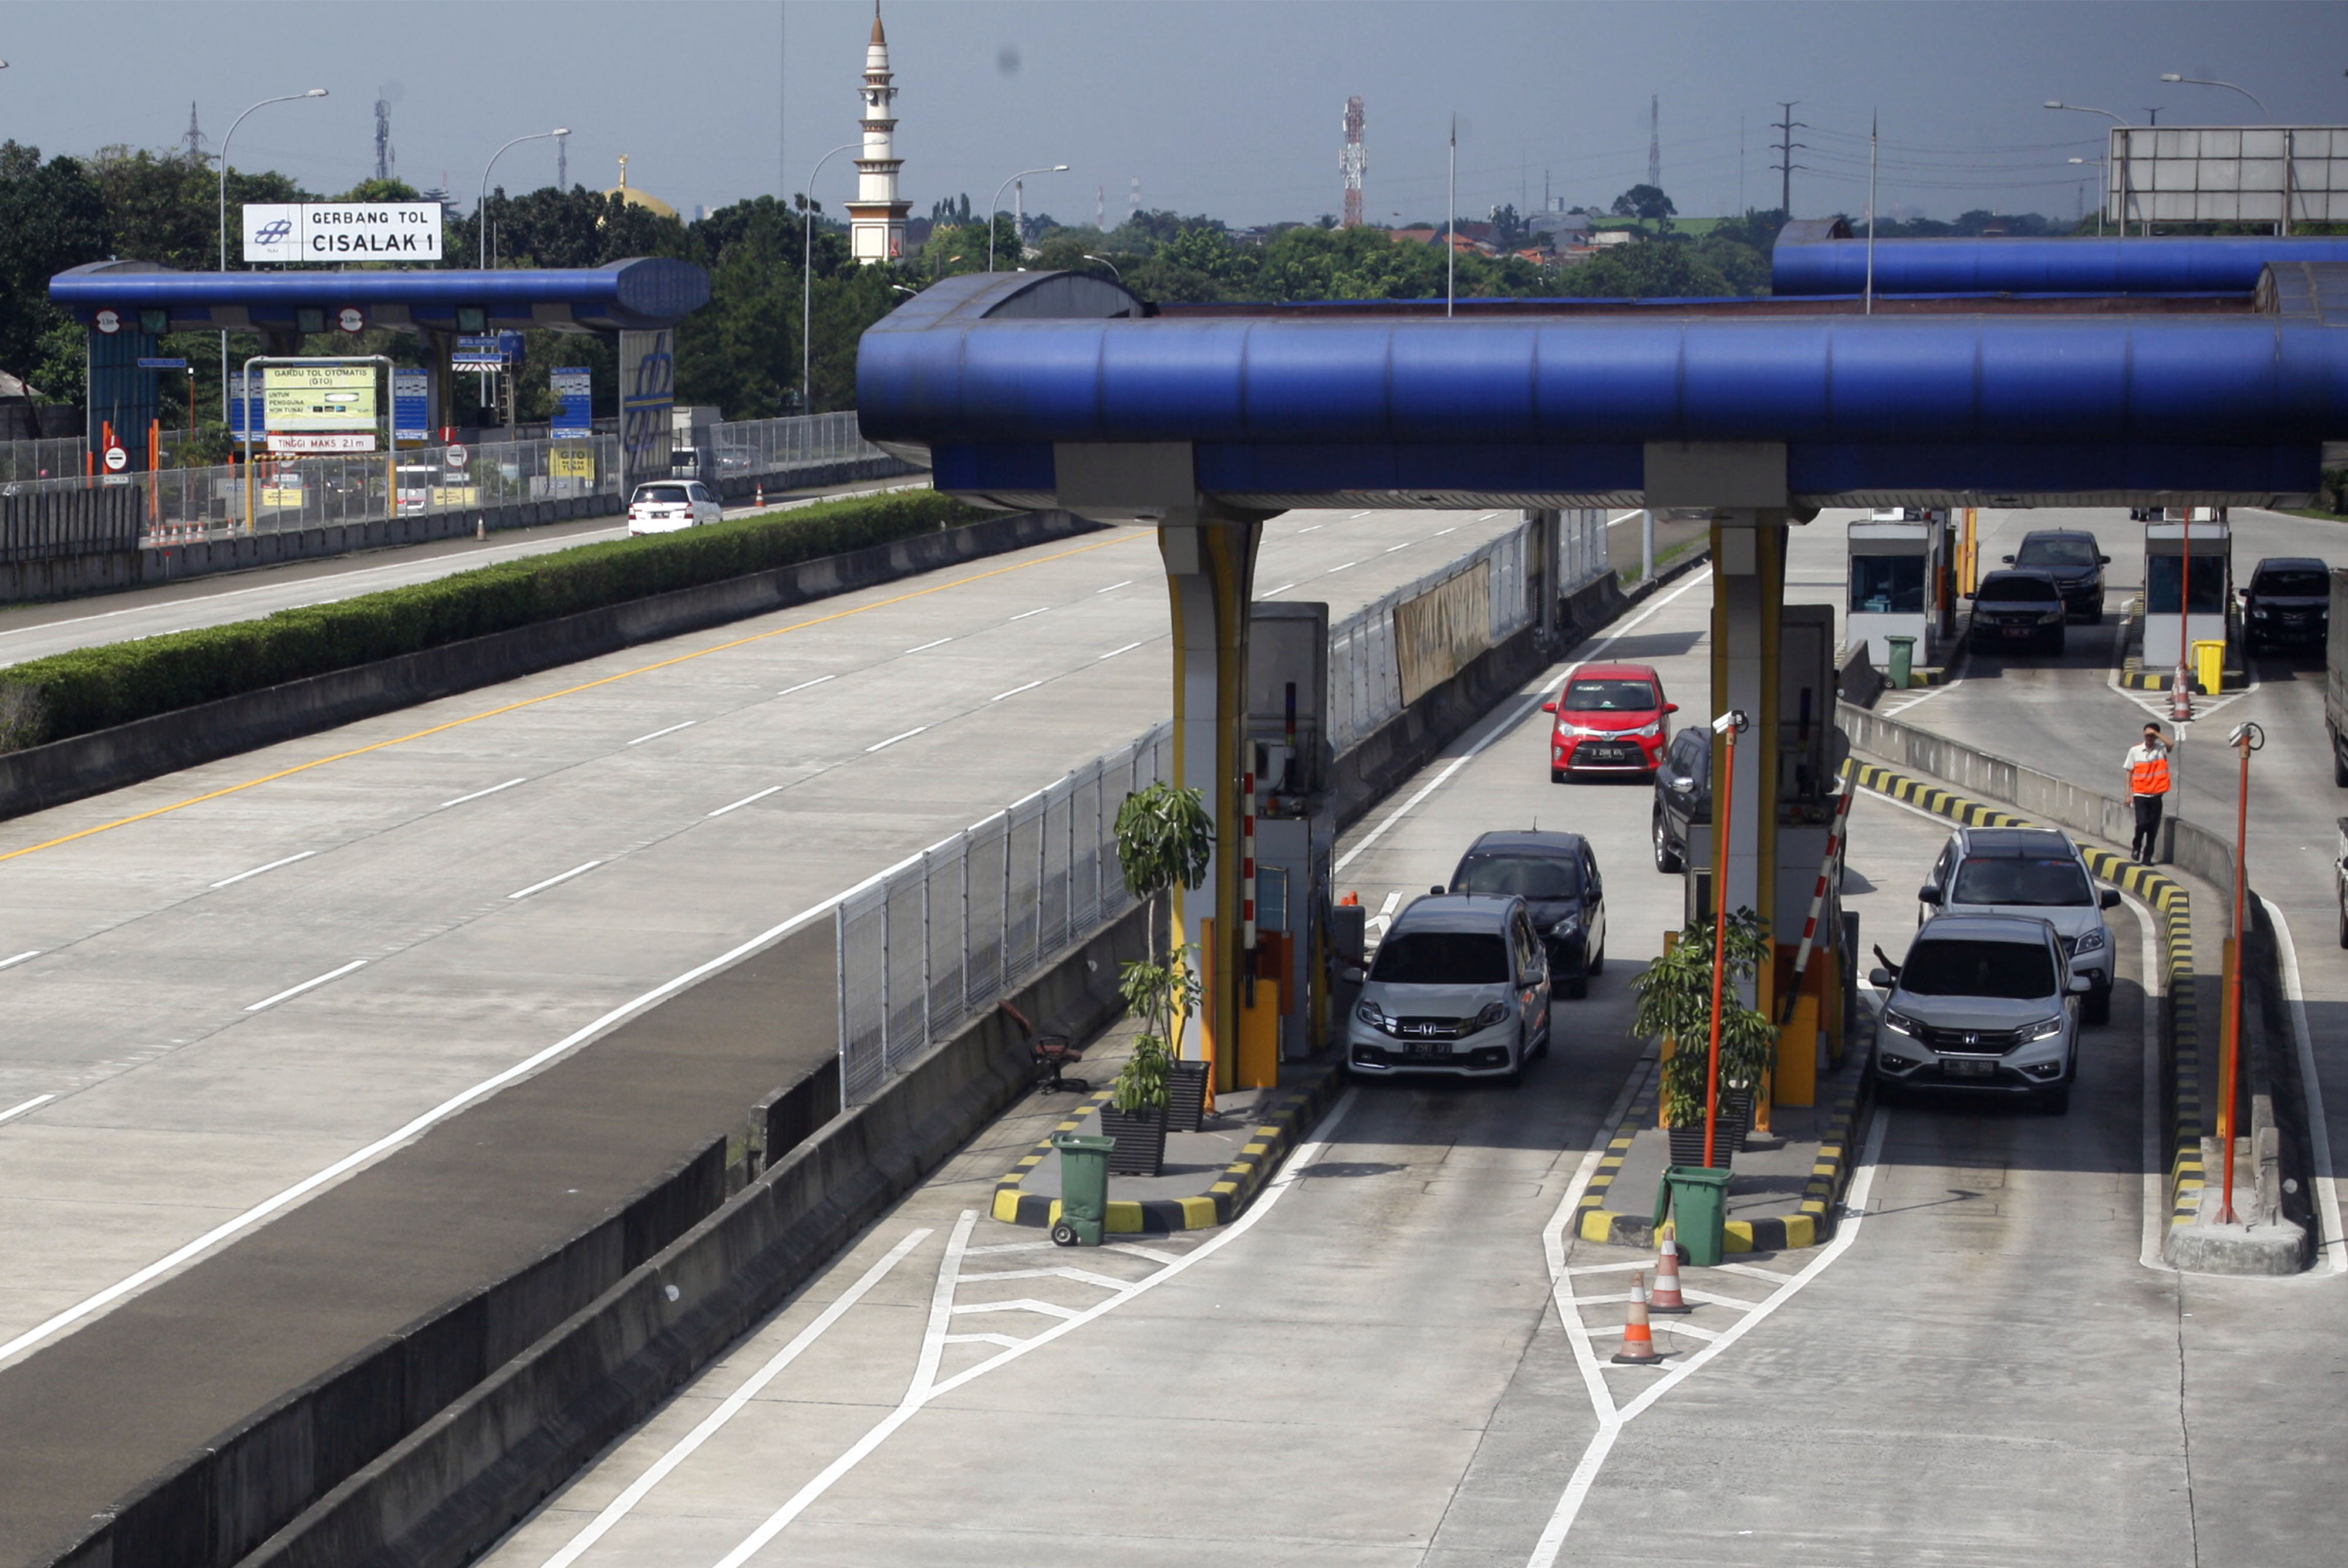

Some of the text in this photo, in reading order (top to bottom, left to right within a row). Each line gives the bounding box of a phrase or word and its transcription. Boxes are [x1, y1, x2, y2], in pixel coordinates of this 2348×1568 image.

[312, 211, 428, 224] GERBANG TOL
[312, 234, 433, 252] CISALAK 1
[309, 377, 333, 386] (GTO)
[278, 440, 305, 448] TINGGI
[311, 440, 336, 448] MAKS
